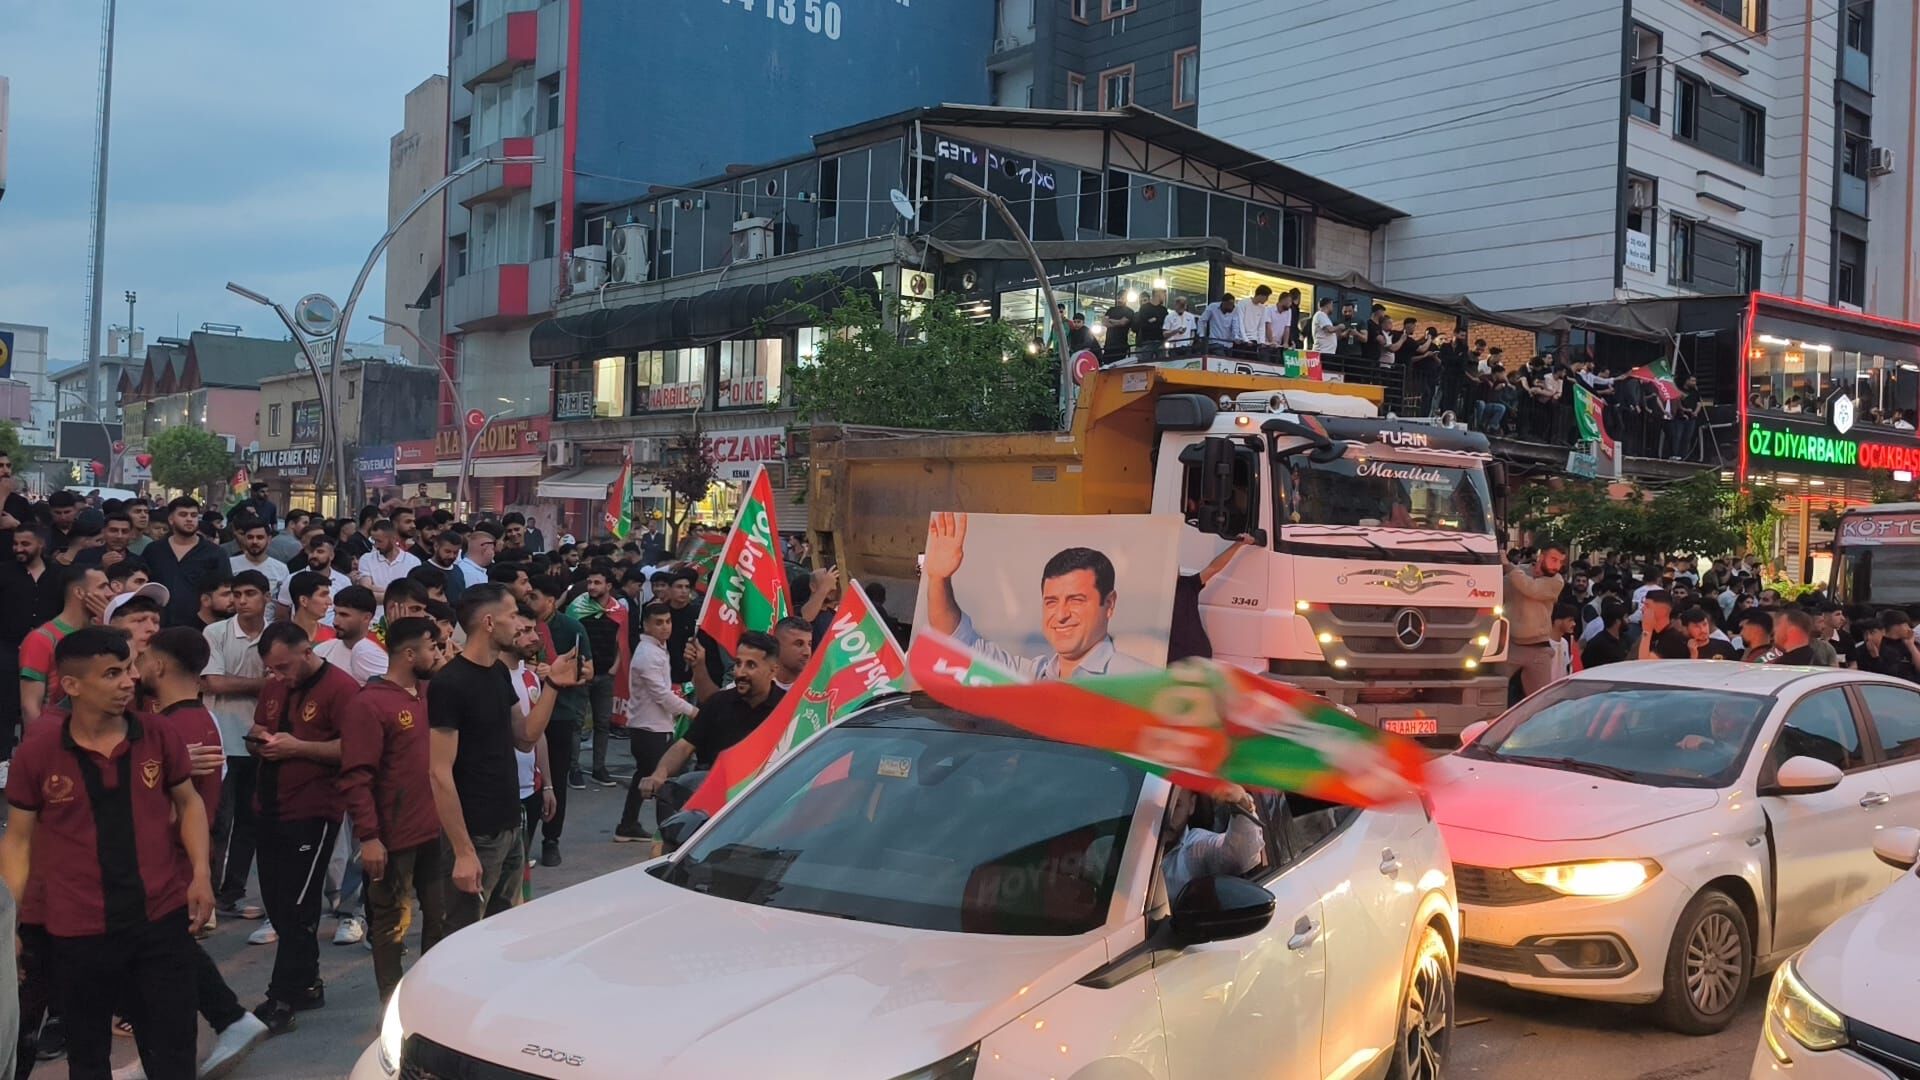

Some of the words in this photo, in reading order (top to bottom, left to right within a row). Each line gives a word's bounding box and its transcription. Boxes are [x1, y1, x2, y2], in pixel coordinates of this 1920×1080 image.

[805, 0, 841, 41] 50
[702, 433, 781, 465] ECZANE
[1379, 429, 1428, 447] TURIN
[1750, 423, 1771, 456] ÖZ
[1774, 427, 1857, 465] DİYARBAKIR
[1231, 596, 1259, 607] 3340
[1419, 720, 1435, 733] 220
